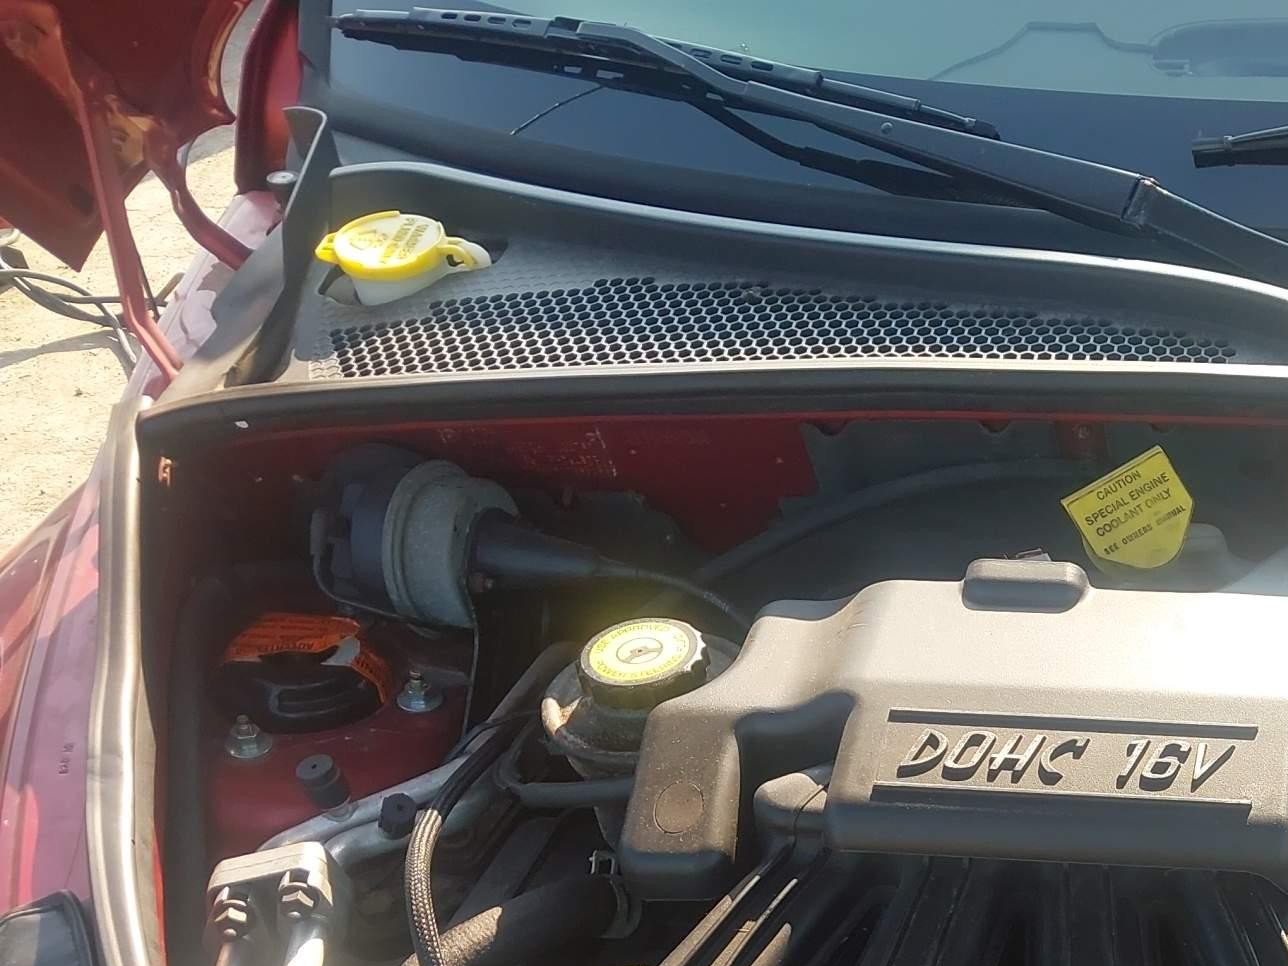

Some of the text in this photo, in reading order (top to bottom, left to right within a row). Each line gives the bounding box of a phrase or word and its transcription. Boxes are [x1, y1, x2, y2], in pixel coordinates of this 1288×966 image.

[1084, 472, 1170, 526] SPECIAL ENGINE
[1096, 470, 1142, 501] CAUTION
[1096, 488, 1172, 537] COOLANT ONLY
[1103, 542, 1119, 555] SEE
[896, 728, 1236, 793] DOHC 16V
